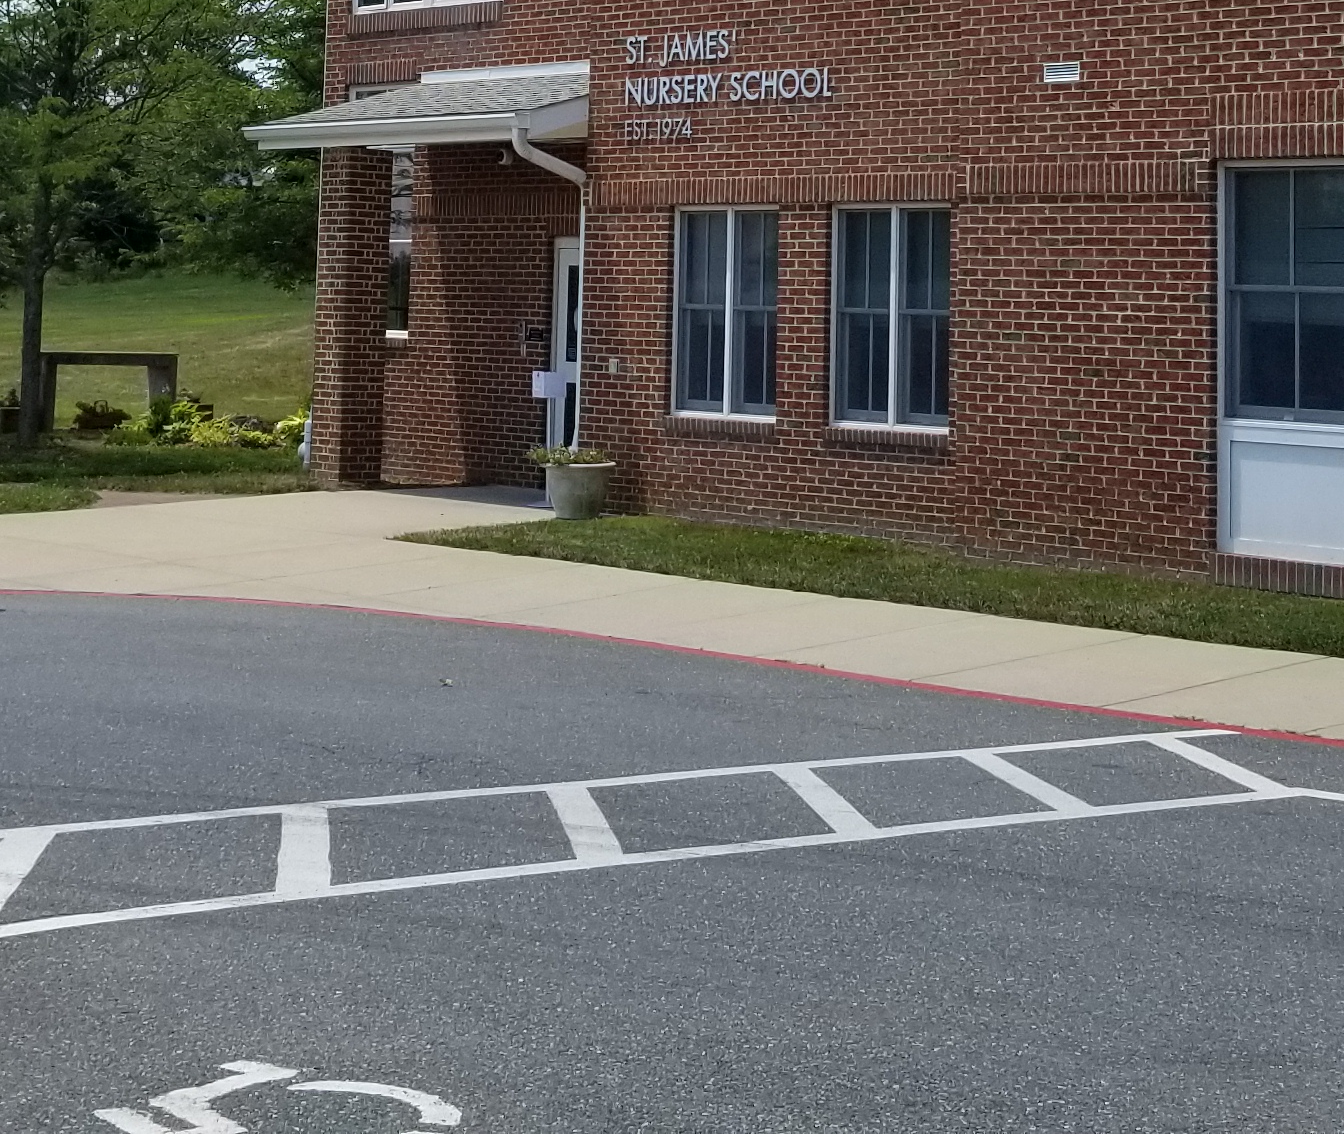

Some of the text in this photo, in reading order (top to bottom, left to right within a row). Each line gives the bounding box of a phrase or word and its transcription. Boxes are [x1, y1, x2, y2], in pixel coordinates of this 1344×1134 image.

[626, 28, 736, 67] ST. JAMES'
[625, 68, 832, 107] NURSERY SCHOOL
[624, 117, 693, 140] EST. 1974
